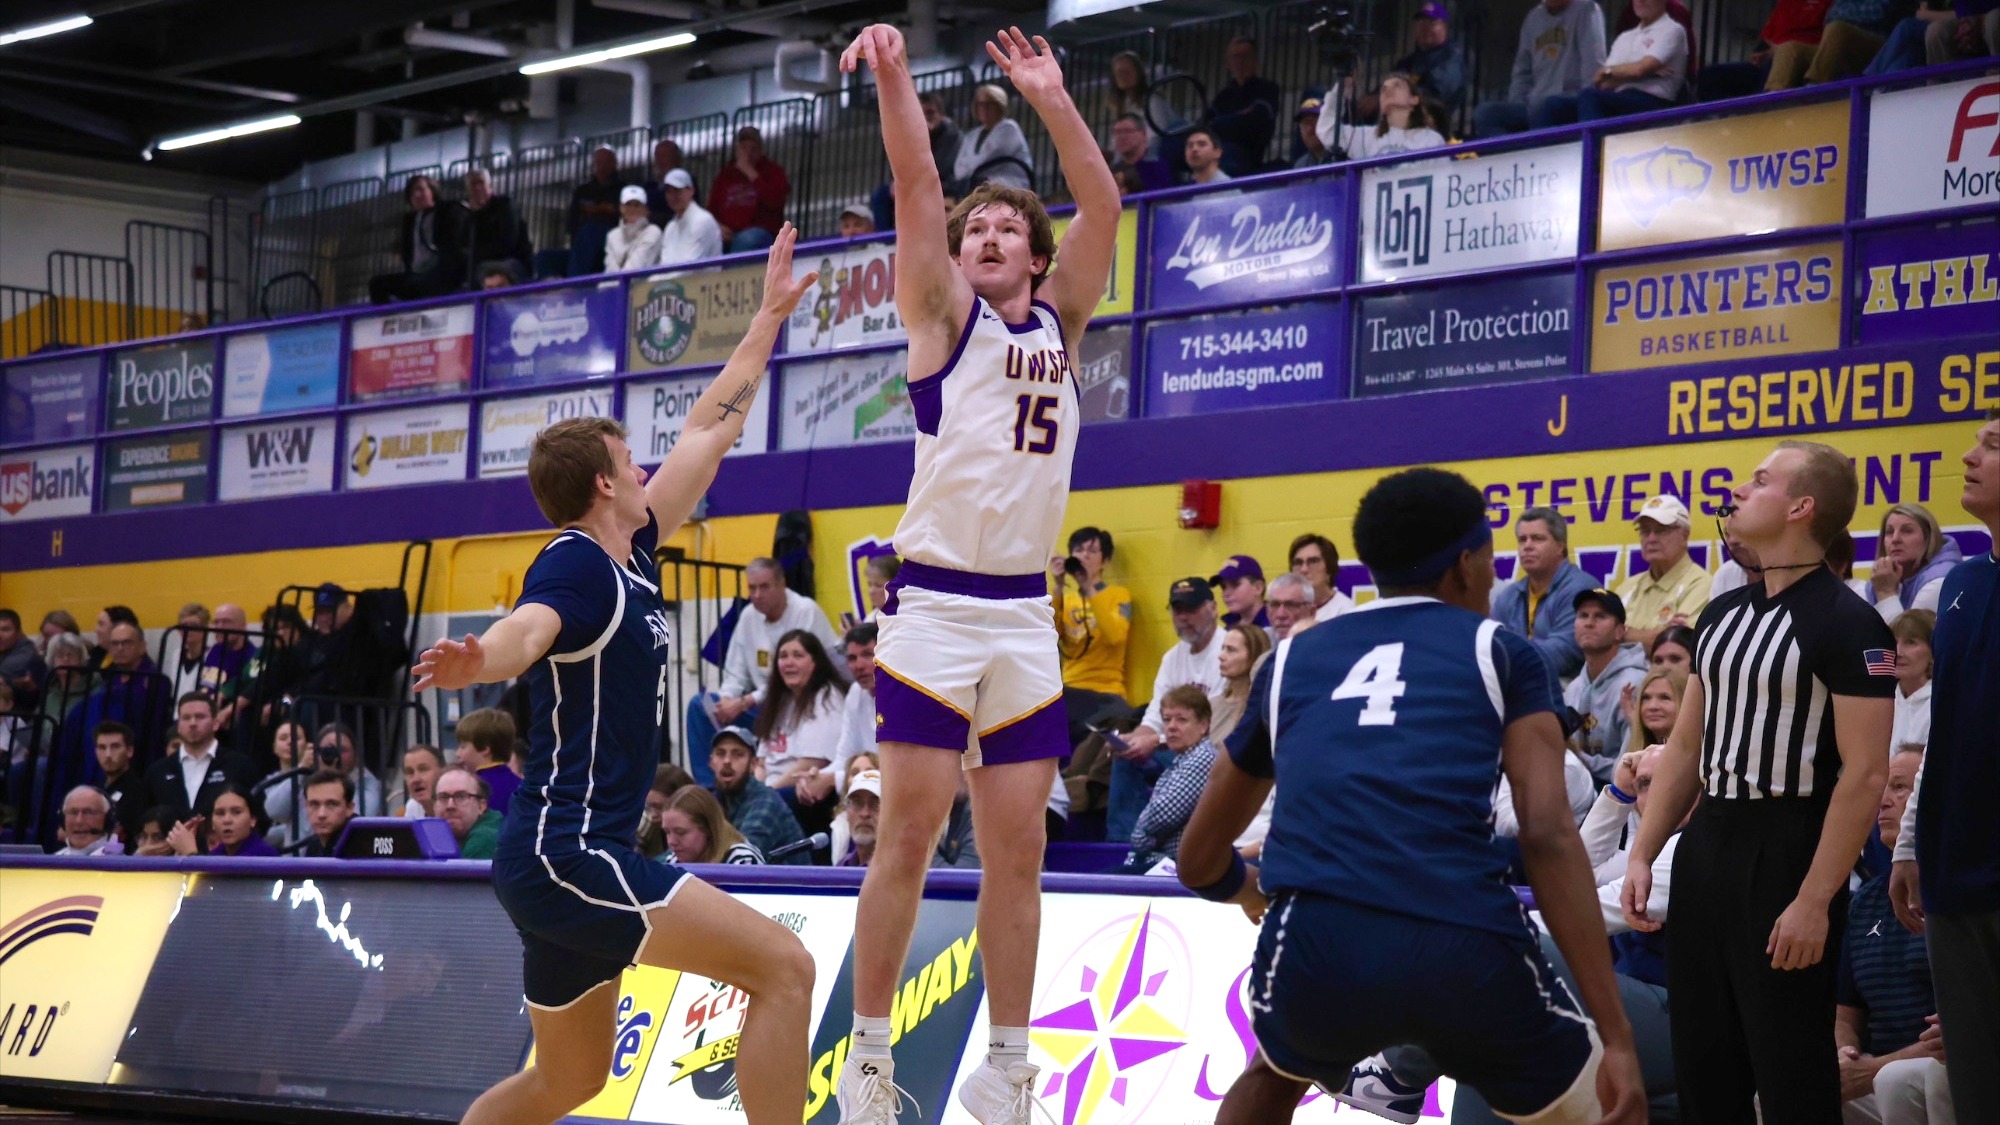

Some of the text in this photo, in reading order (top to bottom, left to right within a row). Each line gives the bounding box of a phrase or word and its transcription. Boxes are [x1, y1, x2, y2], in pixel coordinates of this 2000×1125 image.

[1947, 82, 2000, 163] F
[1445, 163, 1559, 208] Berkshire
[1728, 145, 1838, 194] UWSP
[1166, 203, 1318, 271] Len Dudas
[1443, 212, 1569, 253] Hathaway
[1224, 255, 1282, 277] MOTORS
[1863, 253, 2000, 315] ATHL
[1604, 256, 1833, 324] POINTERS
[636, 294, 696, 331] HILLTOP
[862, 312, 897, 333] Bar &
[1367, 300, 1570, 352] Travel Protection
[1180, 324, 1309, 361] 715-344-3410
[1639, 323, 1790, 356] BASKETBALL
[118, 350, 213, 421] Peoples
[1005, 344, 1069, 385] UWSP
[1162, 361, 1324, 393] lendudasgm.com
[1444, 365, 1465, 378] Main
[1514, 358, 1544, 371] Stevens
[1545, 355, 1566, 367] Point
[1668, 351, 2000, 435] RESERVED SE
[1013, 394, 1059, 455] 15
[1547, 394, 1568, 436] J
[120, 445, 170, 468] EXPERIENCE
[247, 426, 315, 469] W&W
[1484, 467, 1734, 529] STEVENS
[52, 530, 63, 557] H
[1331, 641, 1406, 726] 4
[373, 837, 393, 855] POSS
[803, 927, 977, 1125] SUWAY
[709, 1043, 720, 1061] &
